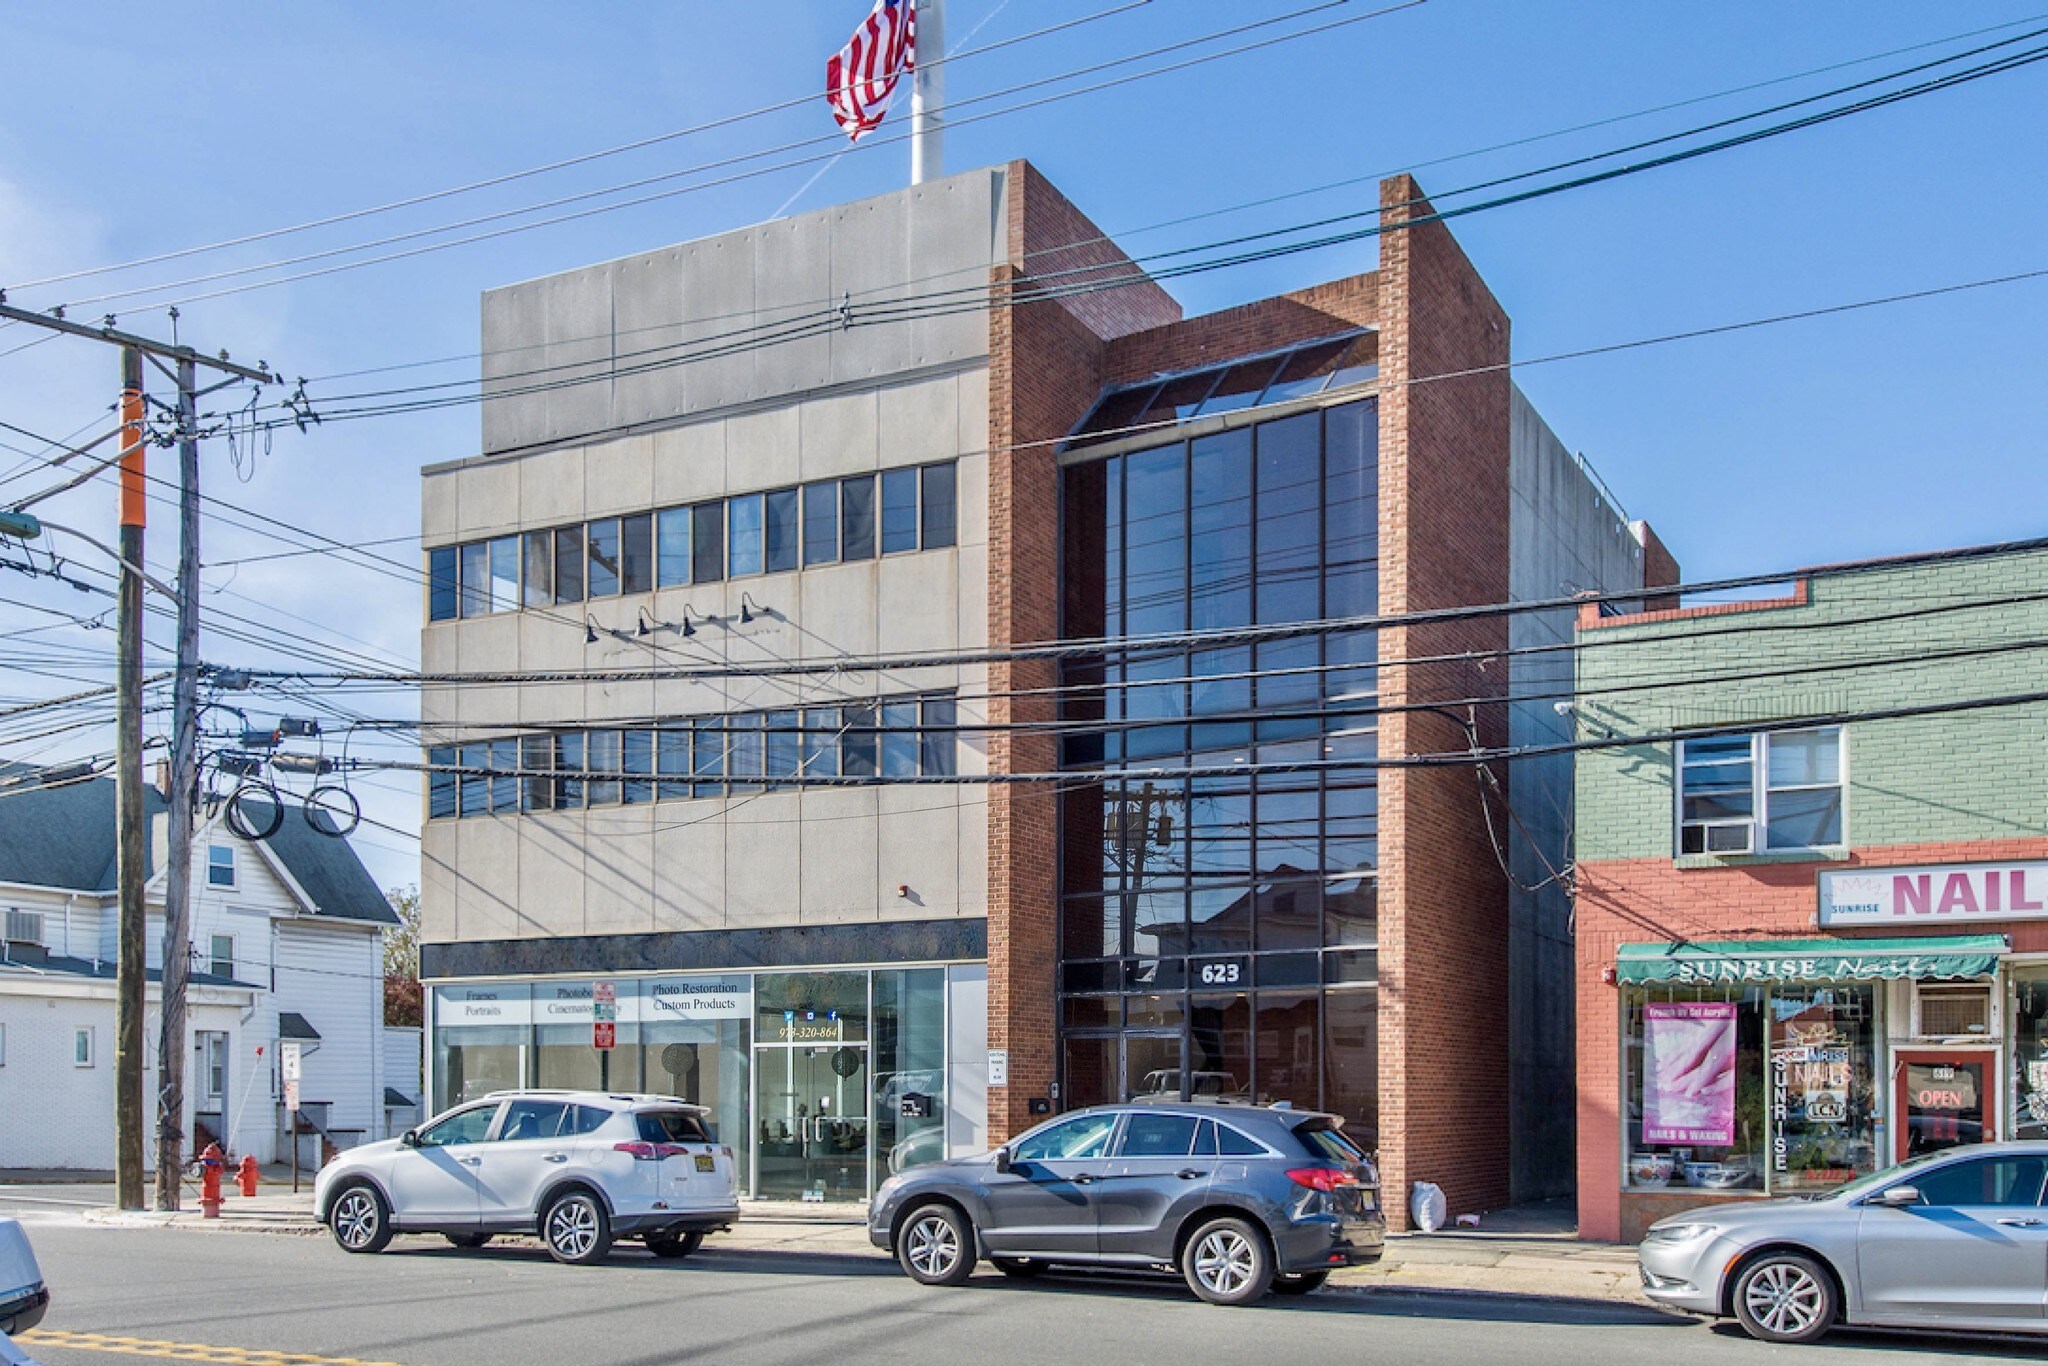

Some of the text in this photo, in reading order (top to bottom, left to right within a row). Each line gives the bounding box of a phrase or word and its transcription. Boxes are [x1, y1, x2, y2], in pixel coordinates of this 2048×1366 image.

[1893, 869, 2048, 915] NAIL
[1831, 904, 1880, 913] SUNRISE
[1679, 957, 1938, 976] SUNRISE Nails
[1202, 964, 1239, 983] 623
[653, 982, 737, 995] Photo Restoration
[465, 1005, 501, 1016] Portraits
[653, 998, 735, 1010] Custom Products
[1920, 1089, 1962, 1106] OPEN
[1774, 1054, 1787, 1171] SUNRISE
[1813, 1103, 1838, 1116] LCN
[1648, 1129, 1677, 1139] NAILS
[1690, 1130, 1728, 1141] WAXING
